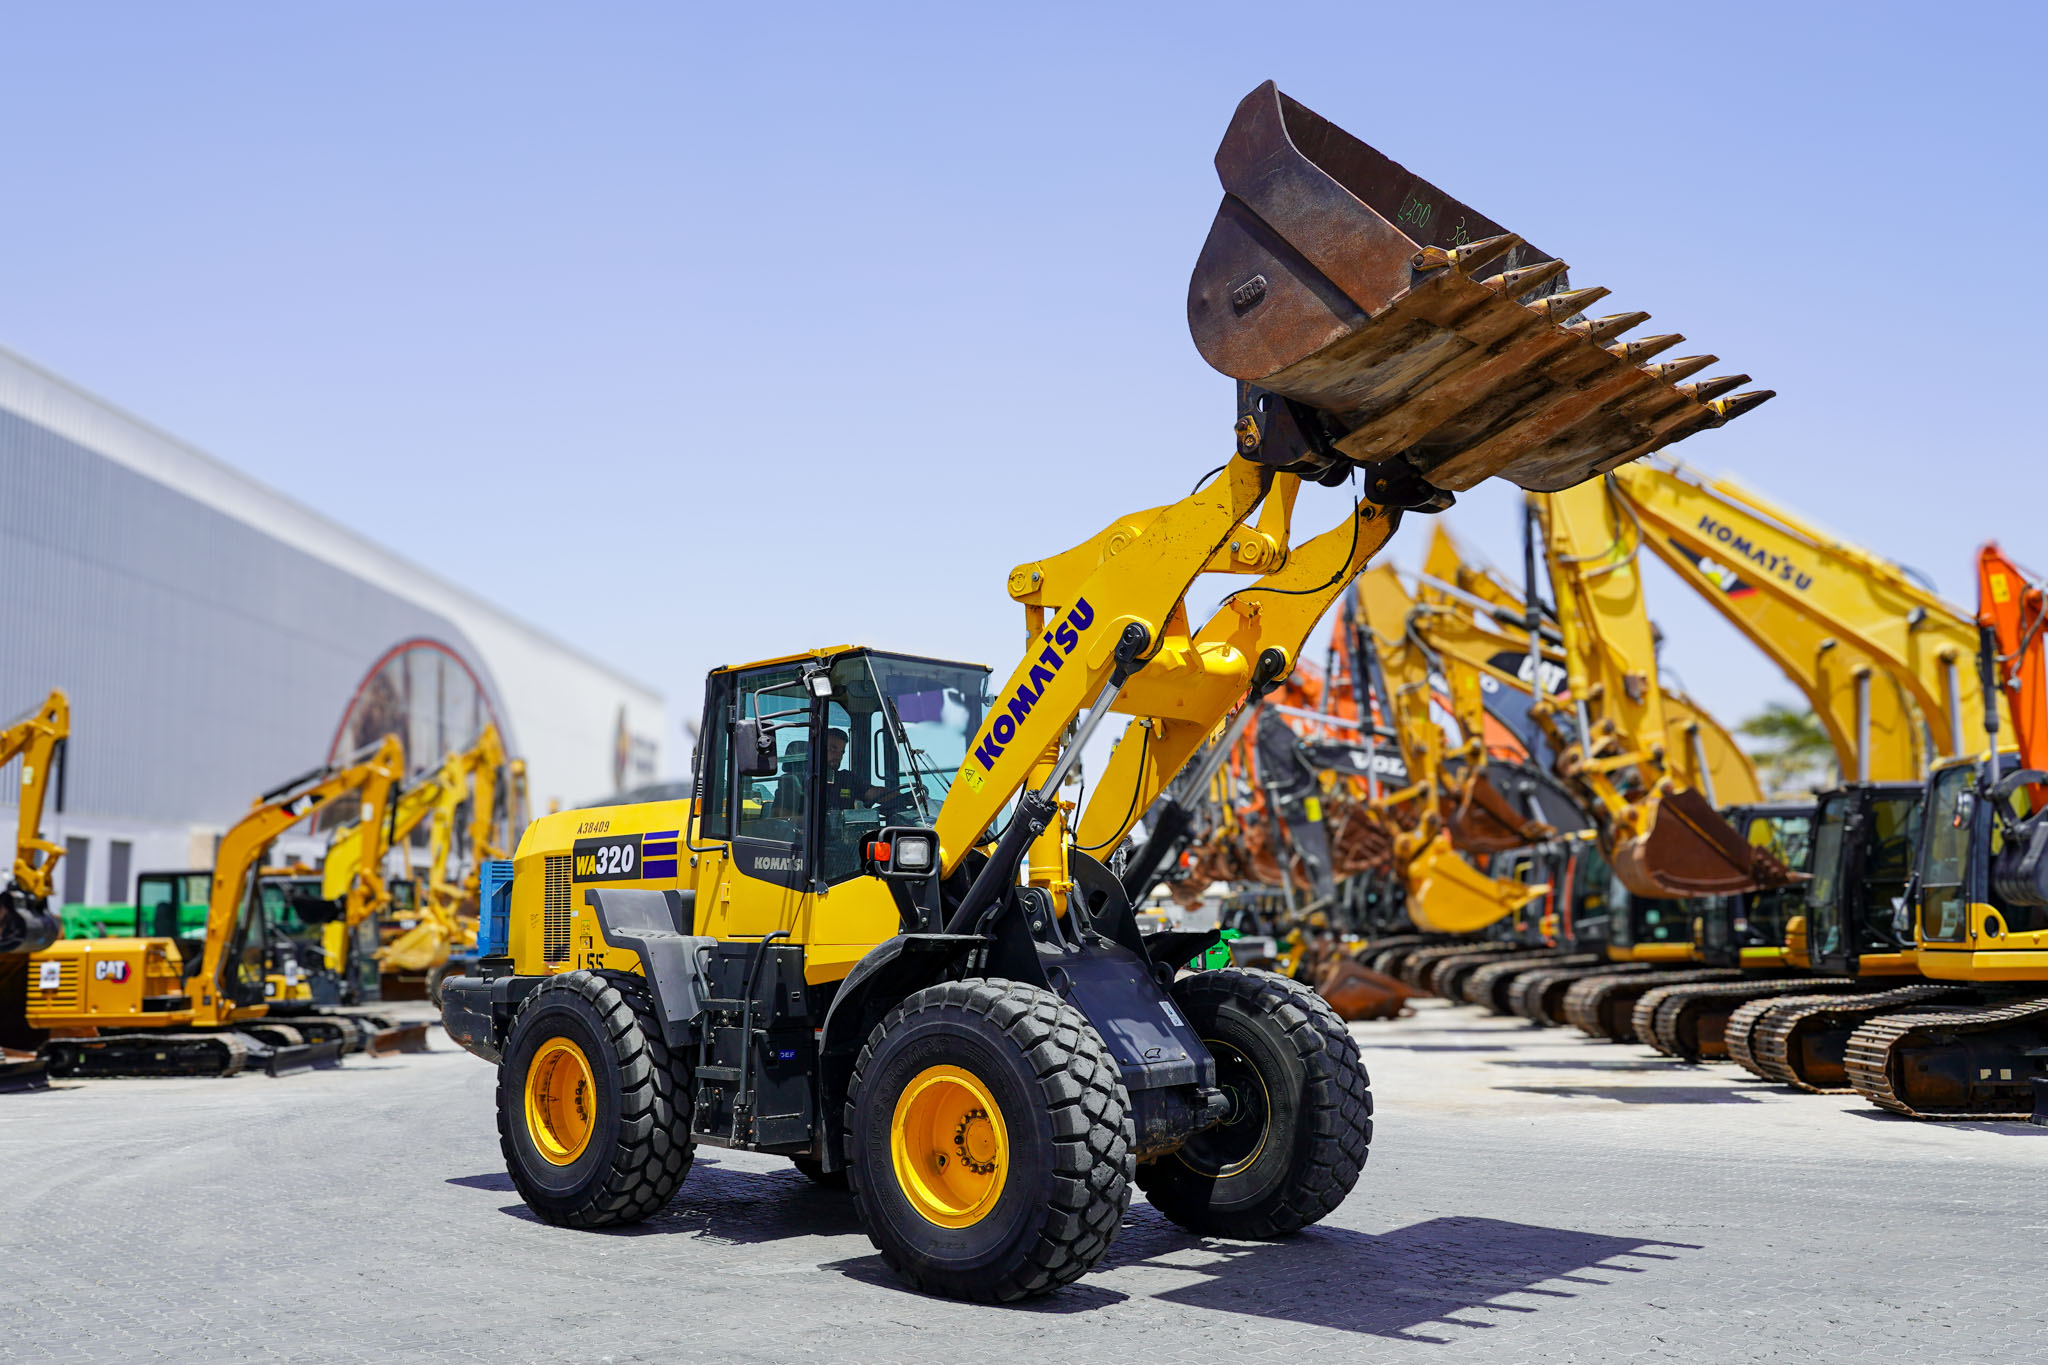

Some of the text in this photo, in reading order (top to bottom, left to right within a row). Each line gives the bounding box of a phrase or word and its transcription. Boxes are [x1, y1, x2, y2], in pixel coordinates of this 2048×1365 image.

[1697, 514, 1812, 590] KOMATSU
[974, 596, 1095, 772] KOMATSU
[577, 820, 611, 835] A38409
[576, 844, 635, 877] WA320
[95, 960, 126, 981] CAT
